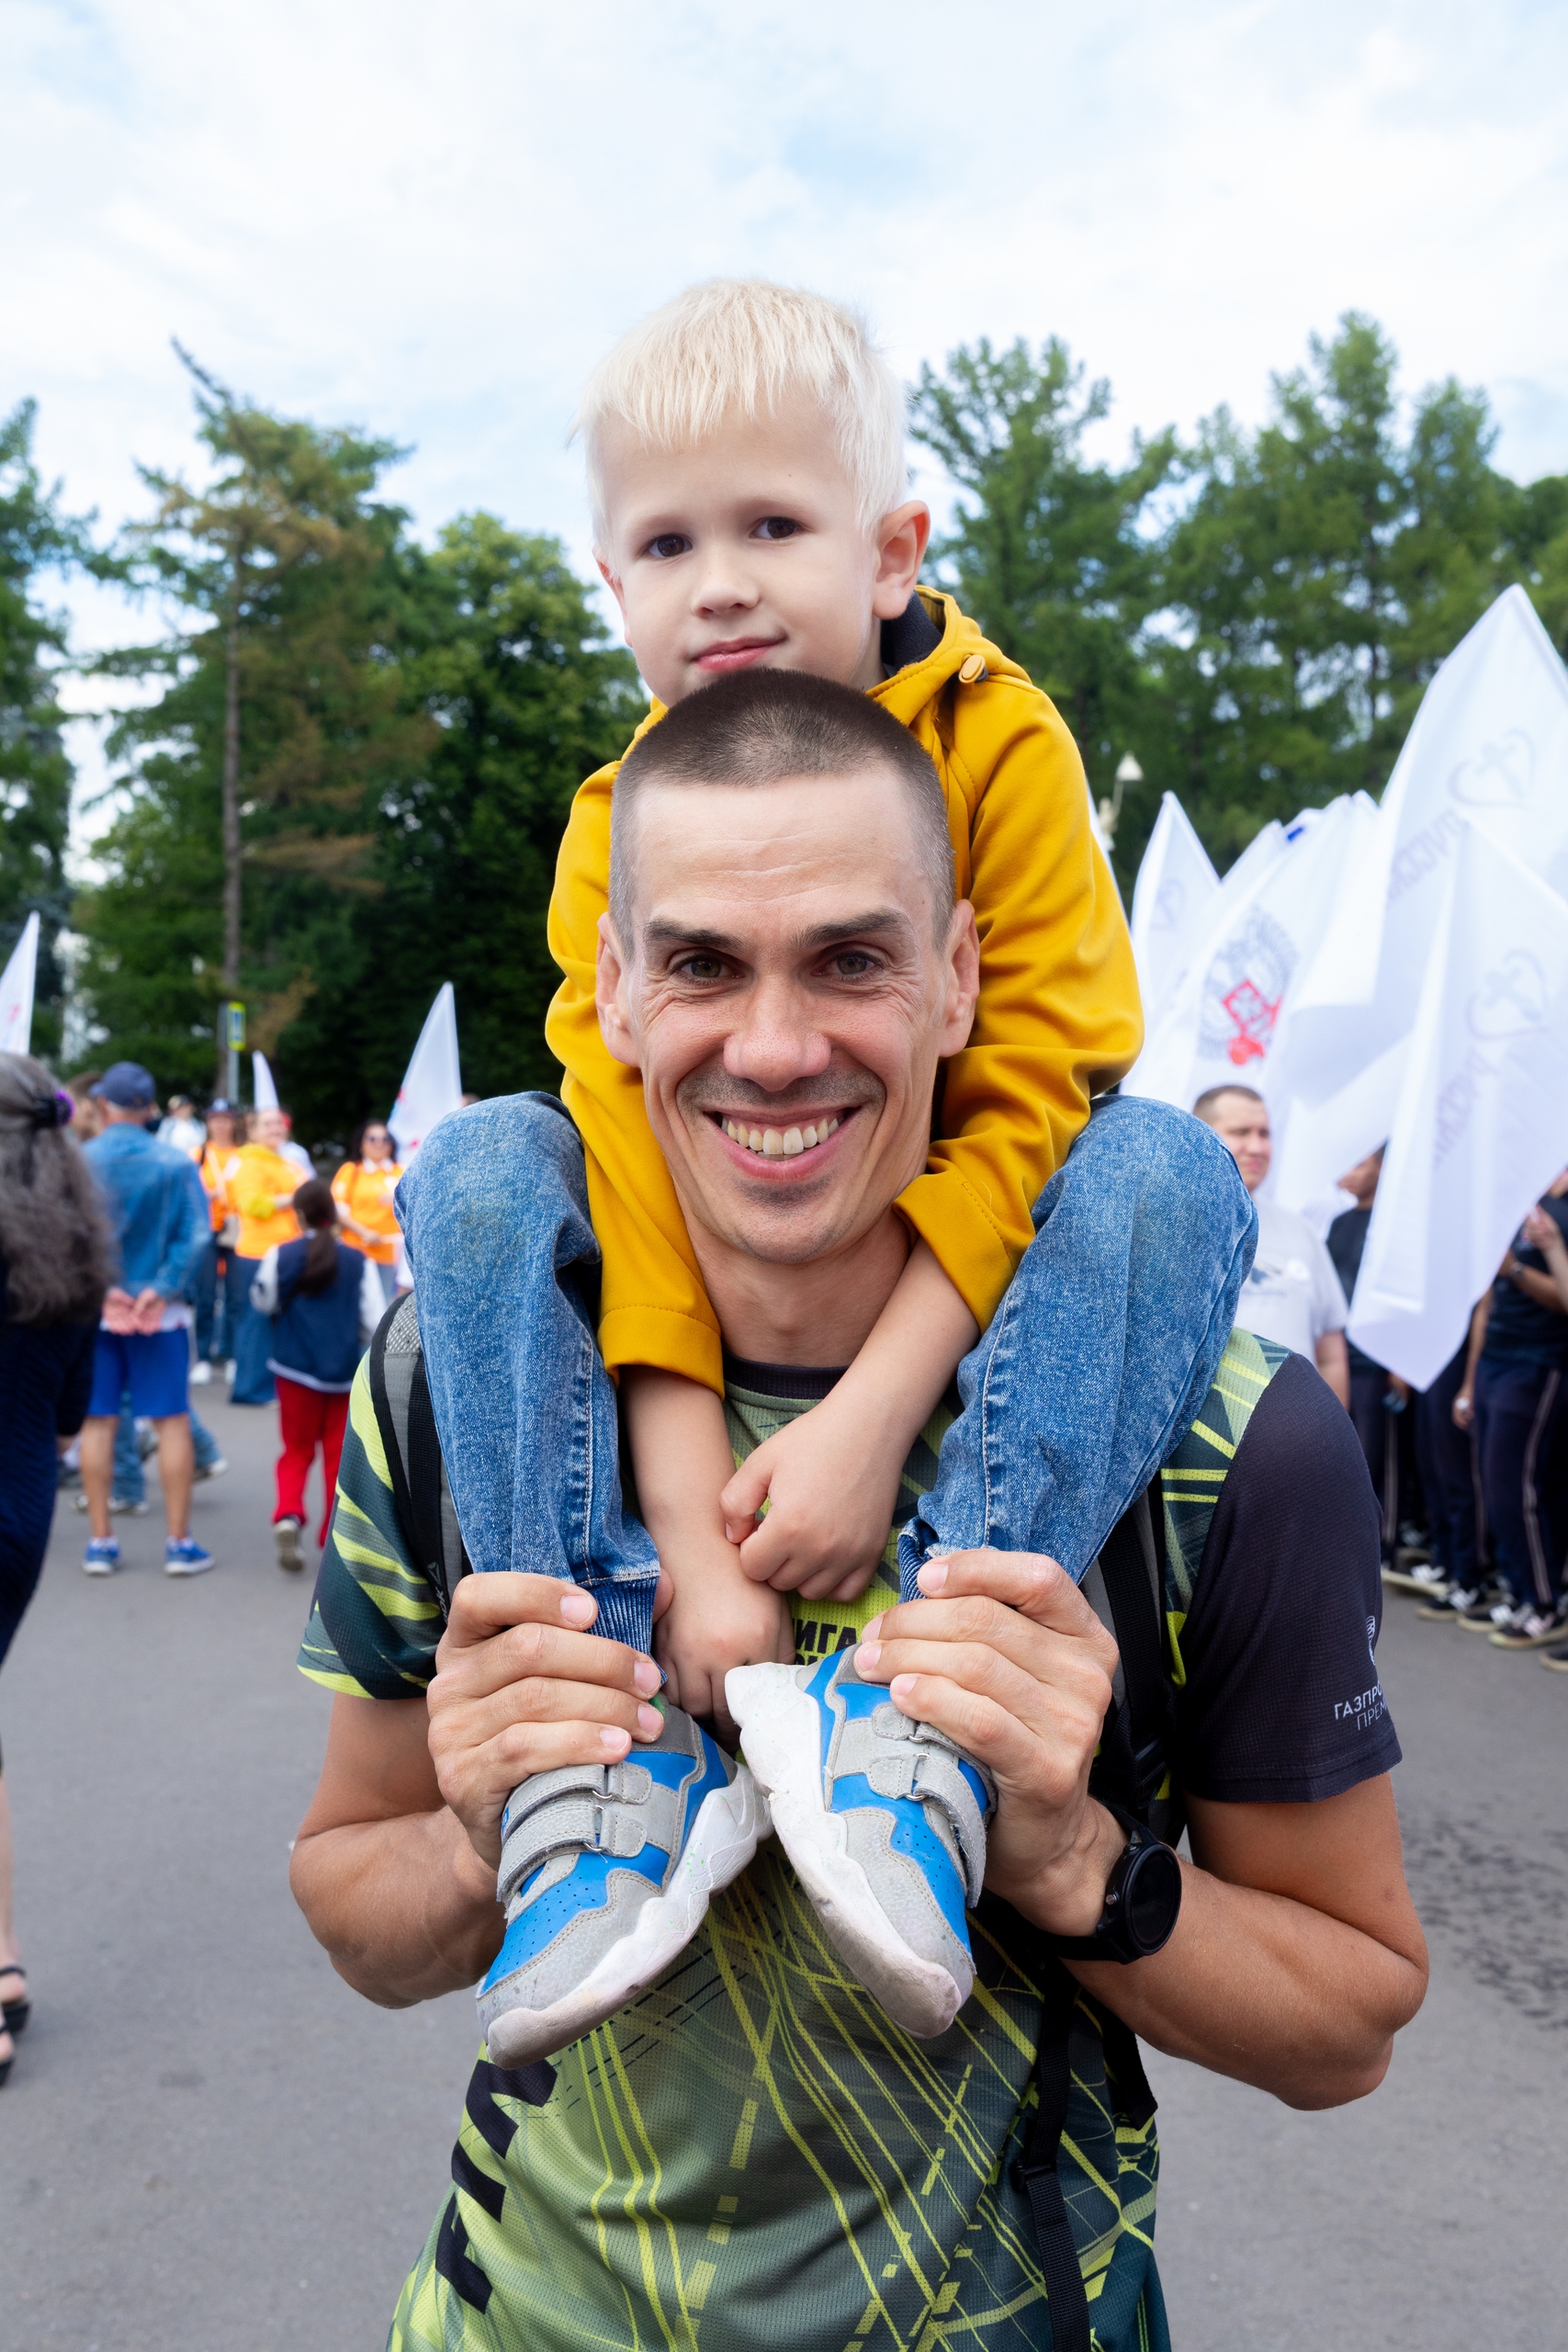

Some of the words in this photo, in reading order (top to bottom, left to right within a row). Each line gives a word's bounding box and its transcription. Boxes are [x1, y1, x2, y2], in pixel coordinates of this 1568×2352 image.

[792, 1619, 857, 1654] ИГА
[1335, 1679, 1382, 1720] ГАЗПРО
[1358, 1697, 1387, 1731] ПРЕМ
